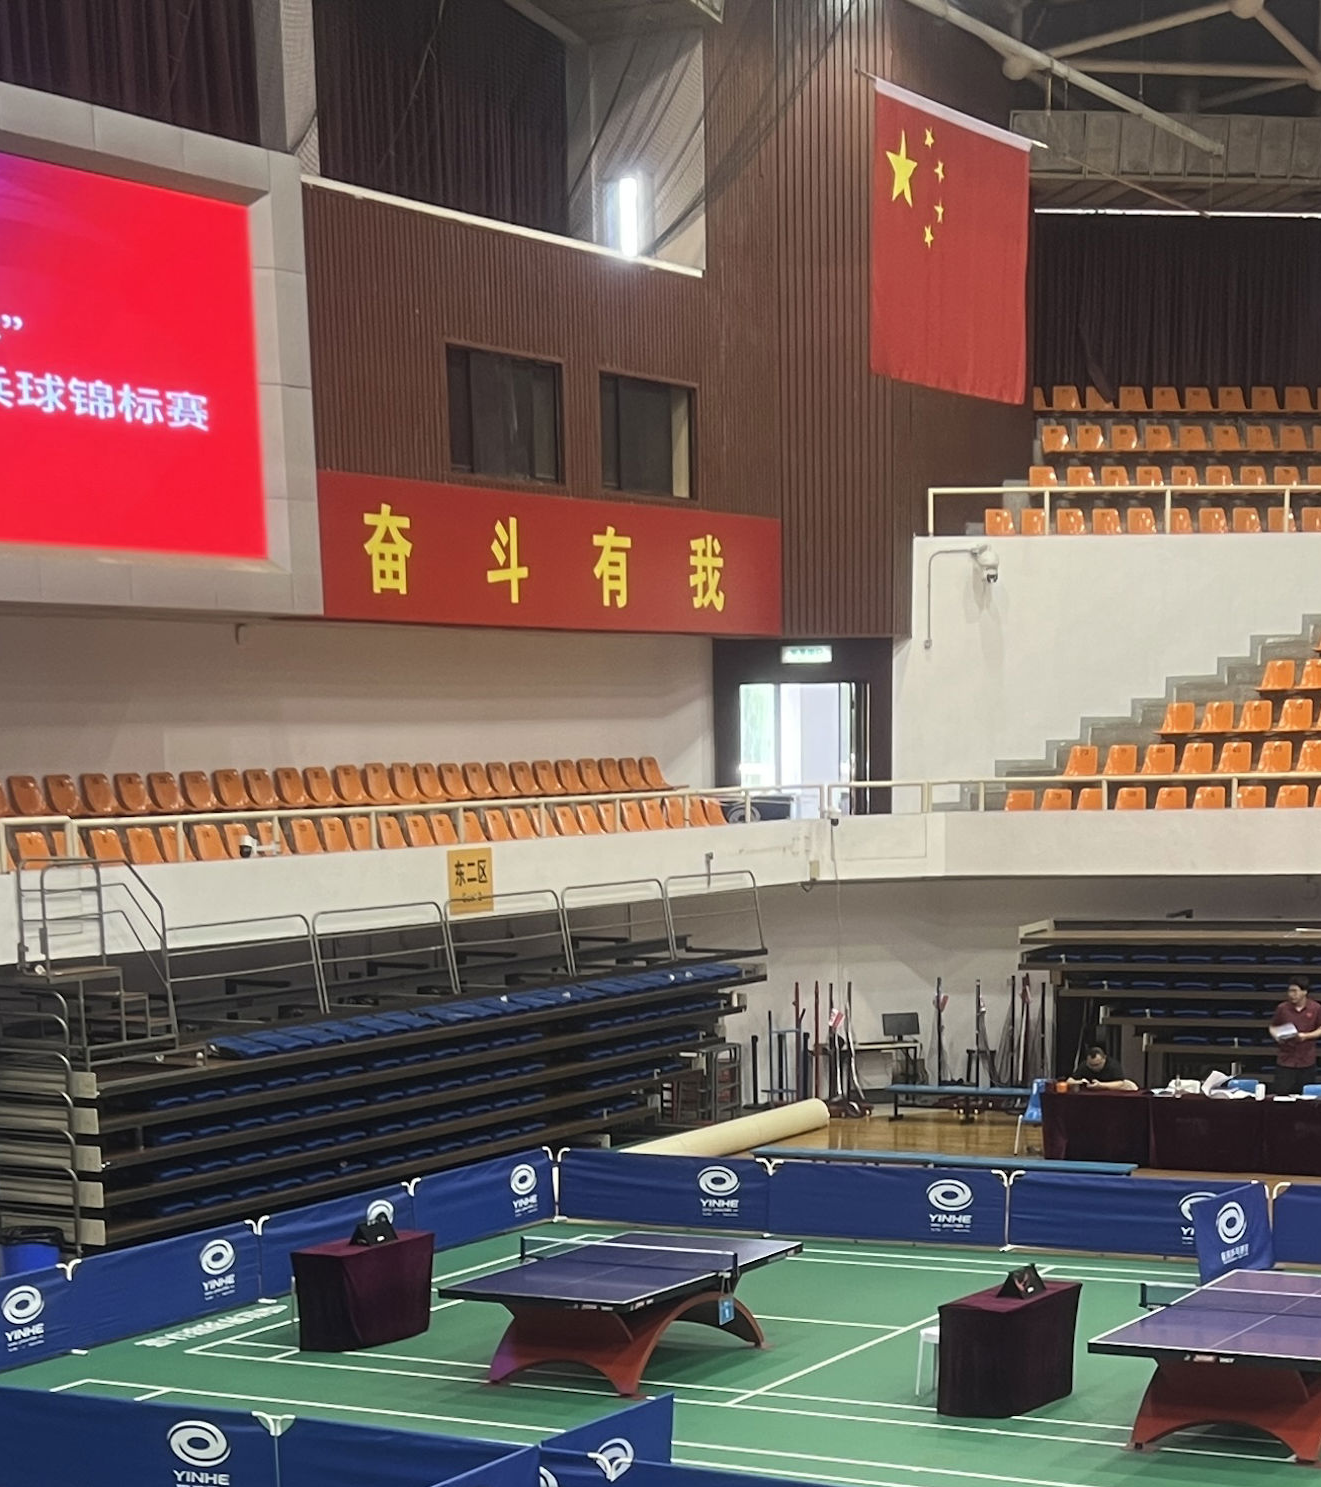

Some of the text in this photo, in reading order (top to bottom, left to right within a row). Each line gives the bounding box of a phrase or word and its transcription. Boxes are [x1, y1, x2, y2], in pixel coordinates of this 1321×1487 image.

[363, 503, 725, 612] 奋斗有我
[454, 859, 488, 886] 东二区
[929, 1214, 972, 1224] YINHE
[5, 1323, 45, 1342] YINHE
[173, 1469, 230, 1486] YINHE
